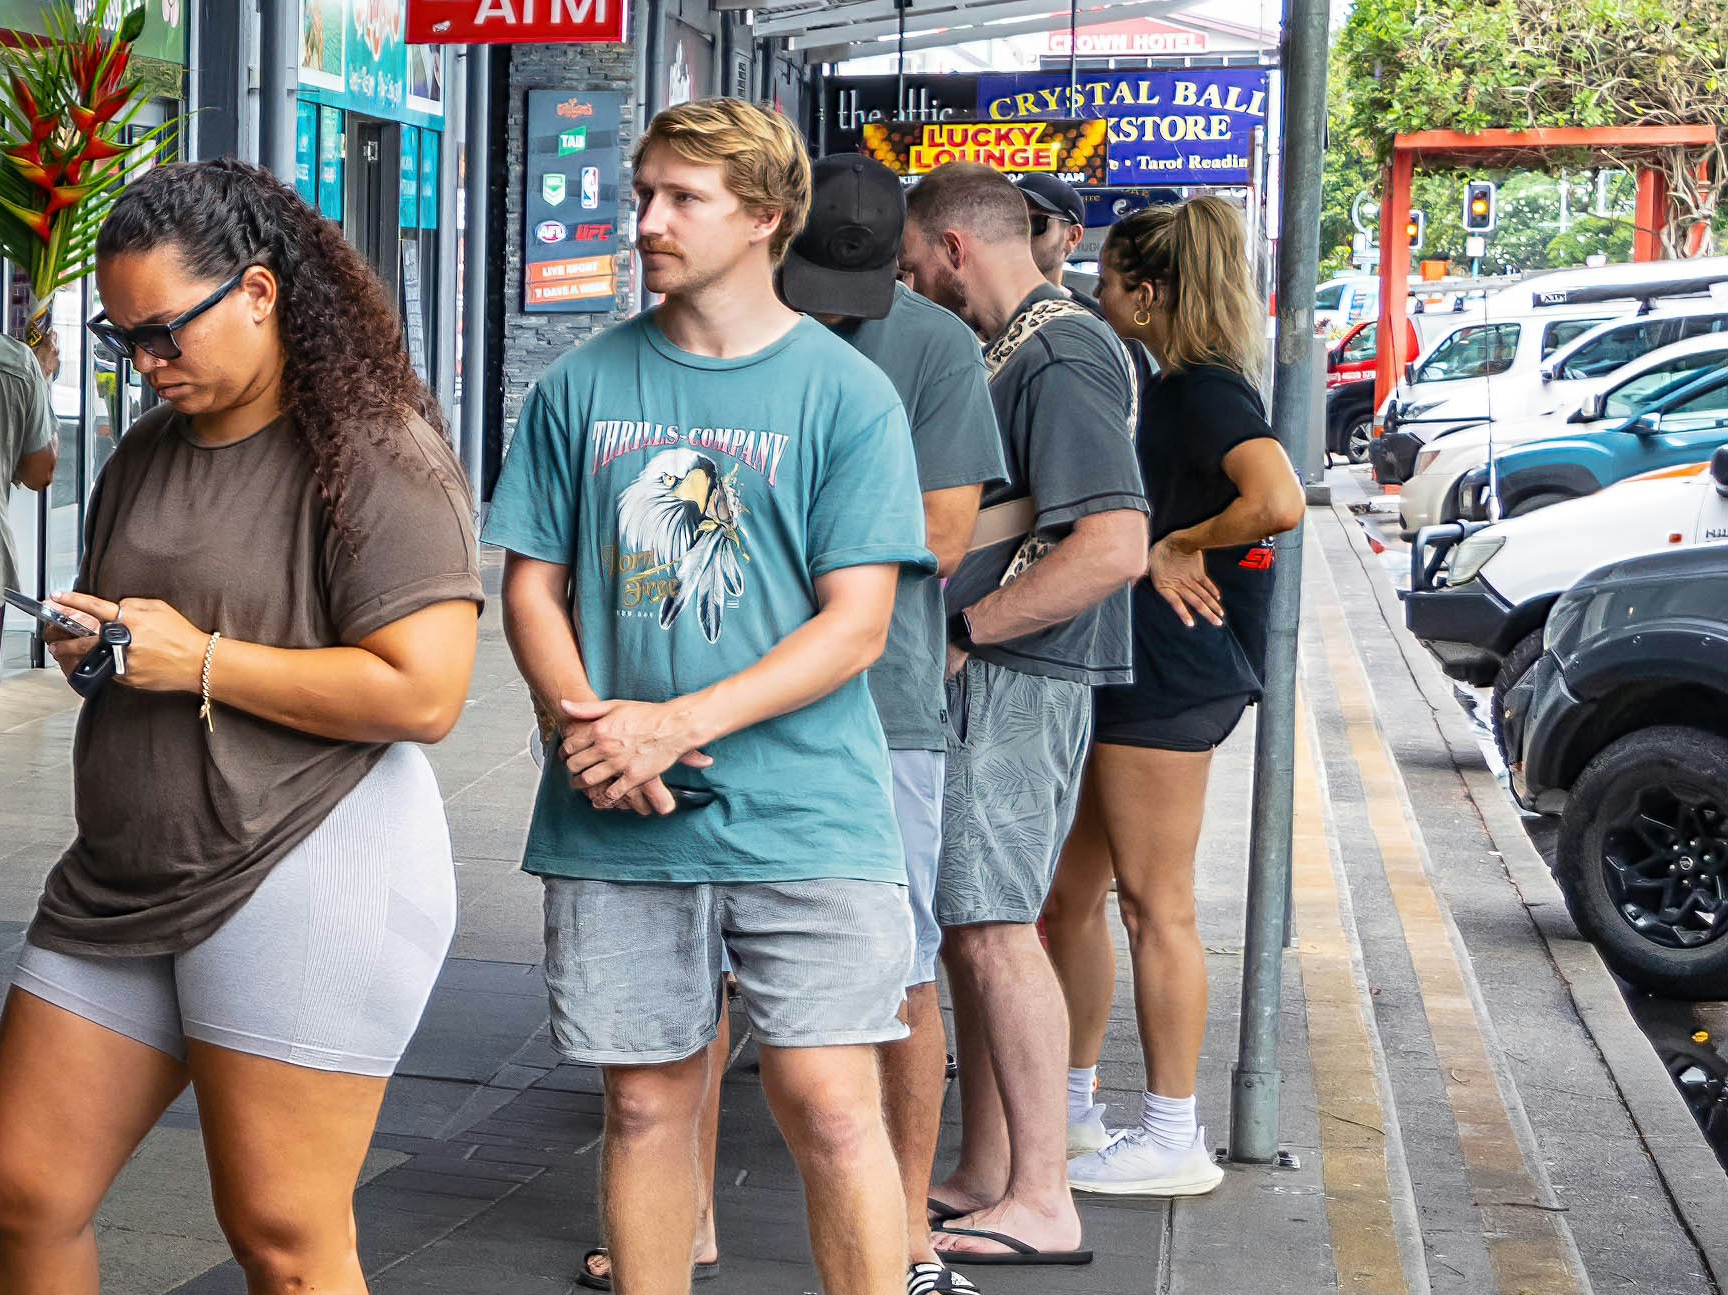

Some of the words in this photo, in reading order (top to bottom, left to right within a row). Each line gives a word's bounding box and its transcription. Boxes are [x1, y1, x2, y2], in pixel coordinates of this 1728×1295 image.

[1050, 33, 1127, 51] CROWN
[1137, 32, 1202, 51] HOTEL
[838, 89, 881, 129] the
[988, 80, 1160, 121] CRYSTAL
[1175, 80, 1265, 117] BALL
[560, 134, 586, 148] TAB
[928, 126, 1037, 148] LUCKY
[1138, 155, 1183, 170] Tarot
[1188, 154, 1248, 170] Readin
[575, 224, 613, 241] UFC
[542, 263, 565, 277] LIVE
[567, 261, 599, 275] SPORT
[543, 285, 568, 298] DAYS
